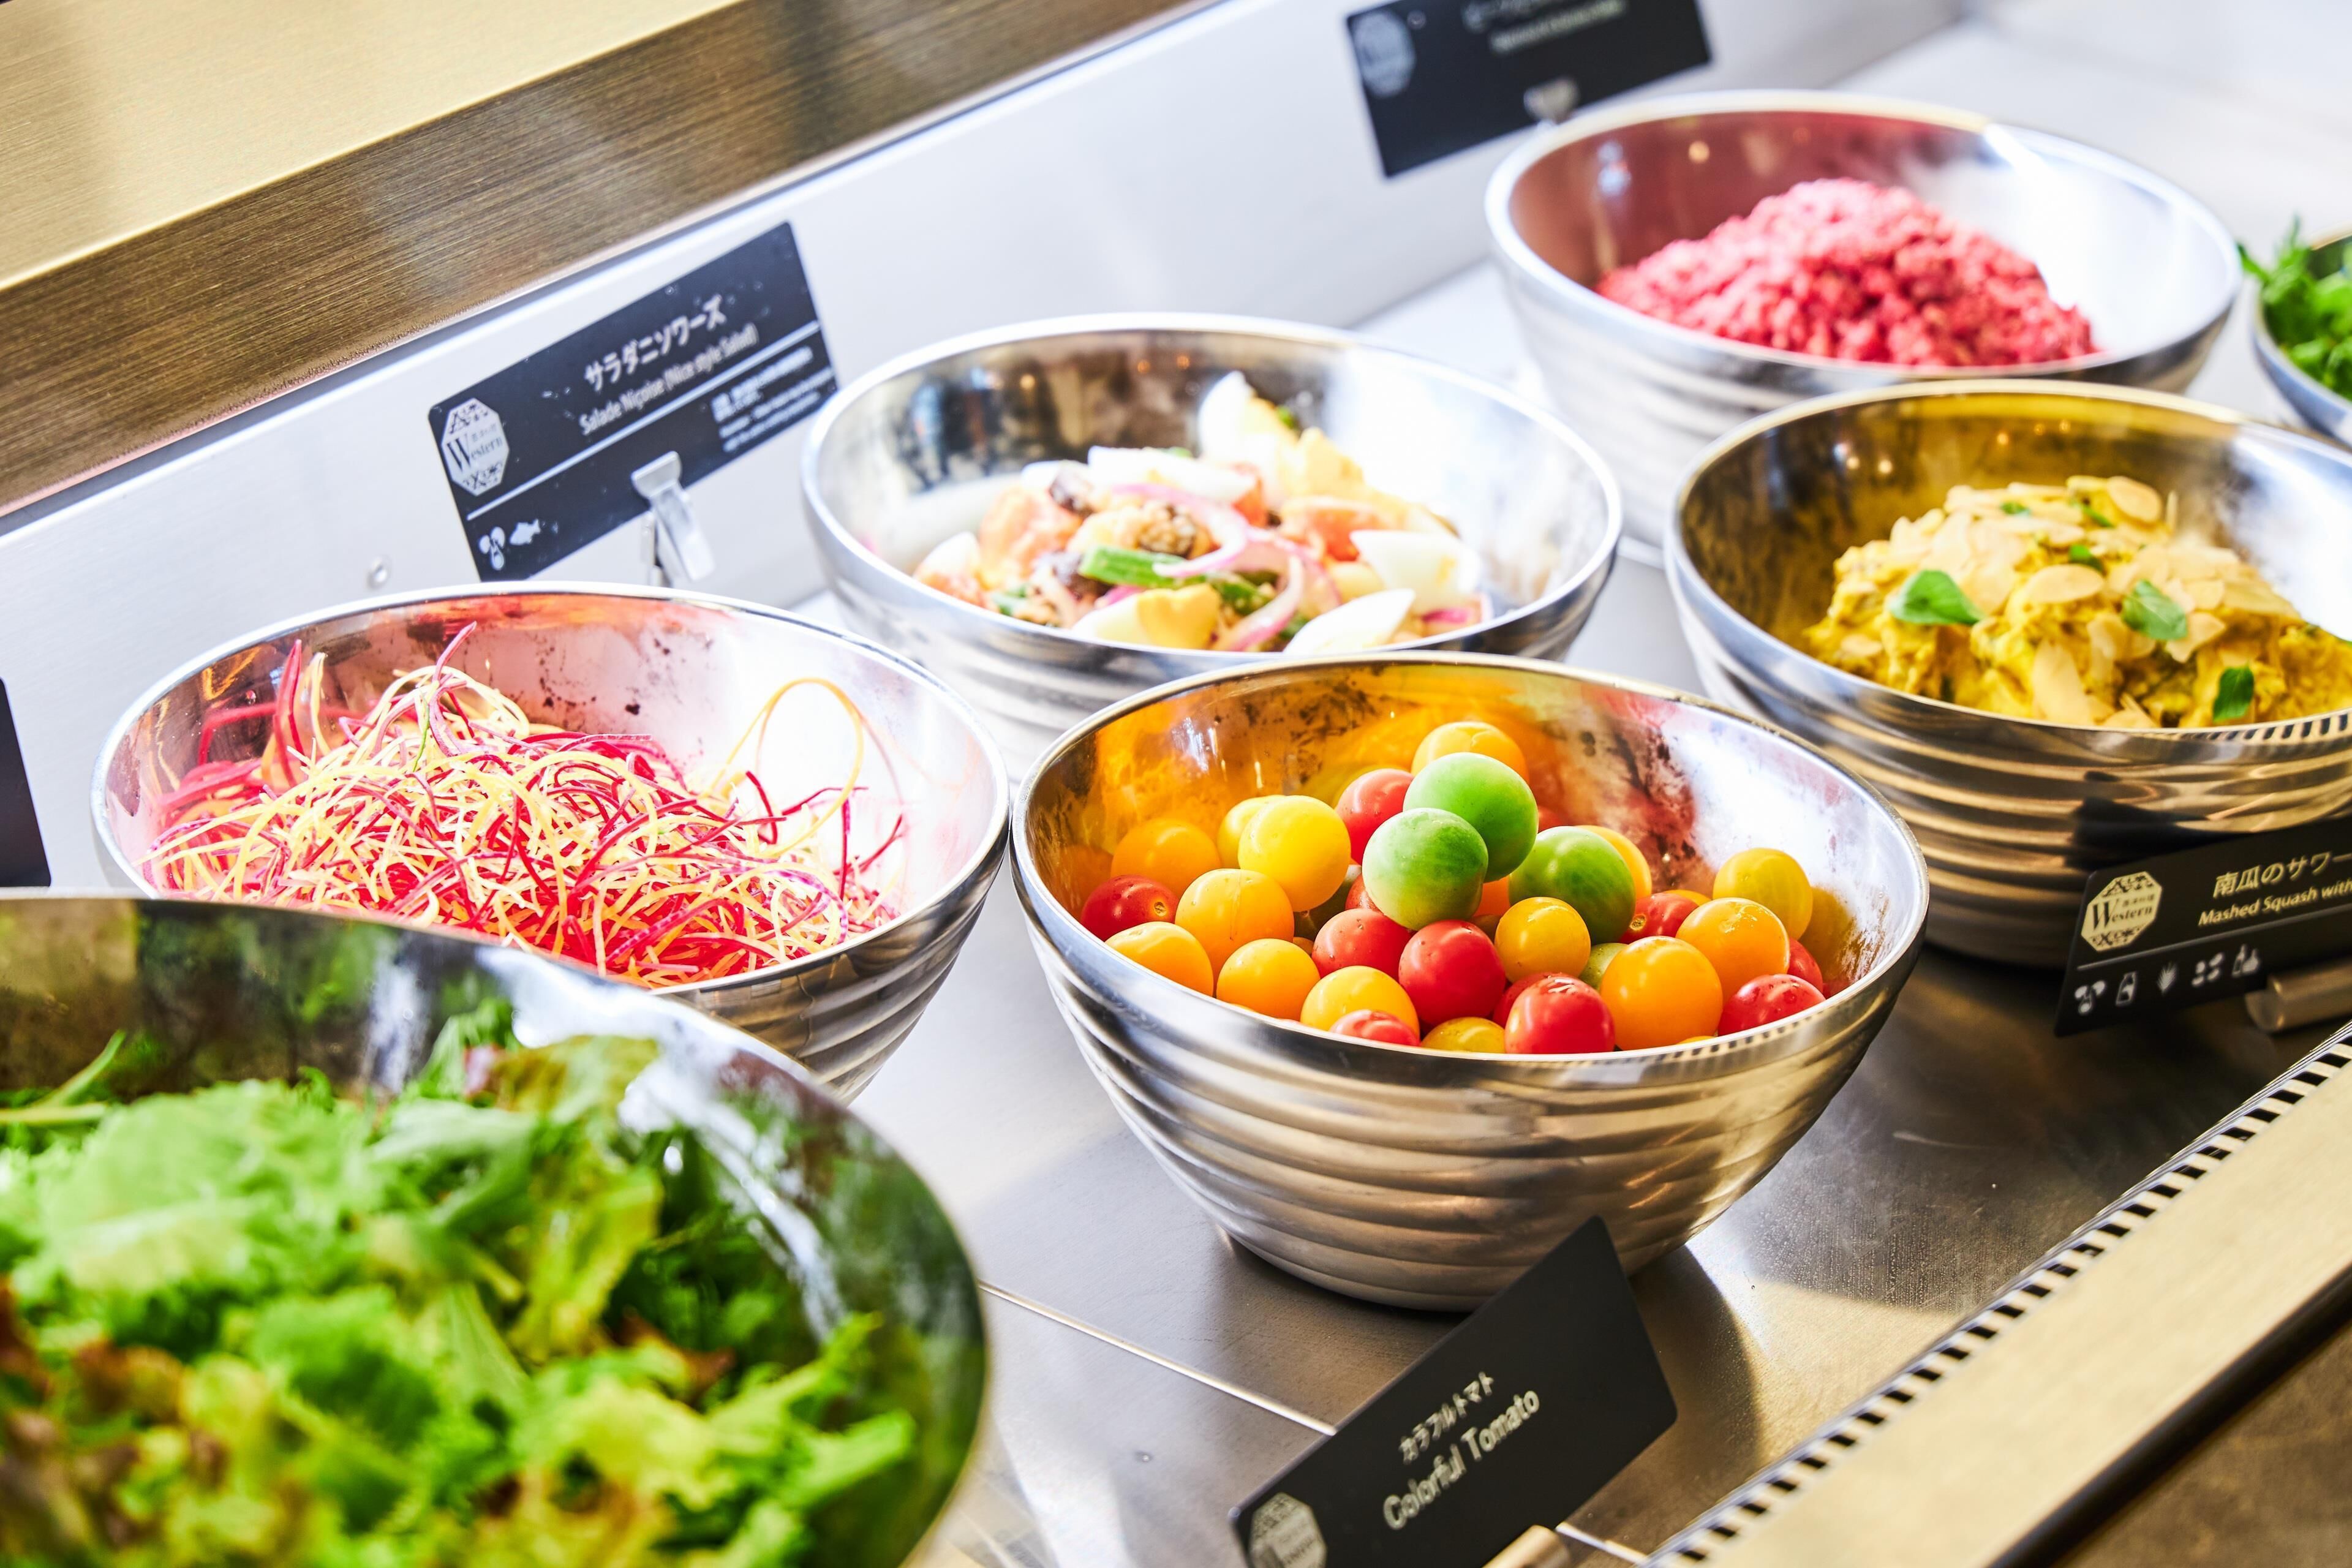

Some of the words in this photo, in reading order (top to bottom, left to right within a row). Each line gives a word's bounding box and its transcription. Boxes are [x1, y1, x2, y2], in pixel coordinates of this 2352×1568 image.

[584, 293, 727, 392] サラダニソワーズ
[580, 401, 622, 435] Salade
[447, 432, 503, 472] Western
[2213, 851, 2352, 899] 南瓜のサワー
[2093, 898, 2152, 930] Western
[2198, 898, 2261, 927] Mashed
[2262, 886, 2318, 913] Squash
[2321, 878, 2352, 899] with
[1398, 1371, 1494, 1464] カラフルトマト
[1384, 1443, 1467, 1530] Colorful
[1460, 1390, 1540, 1461] Tomato
